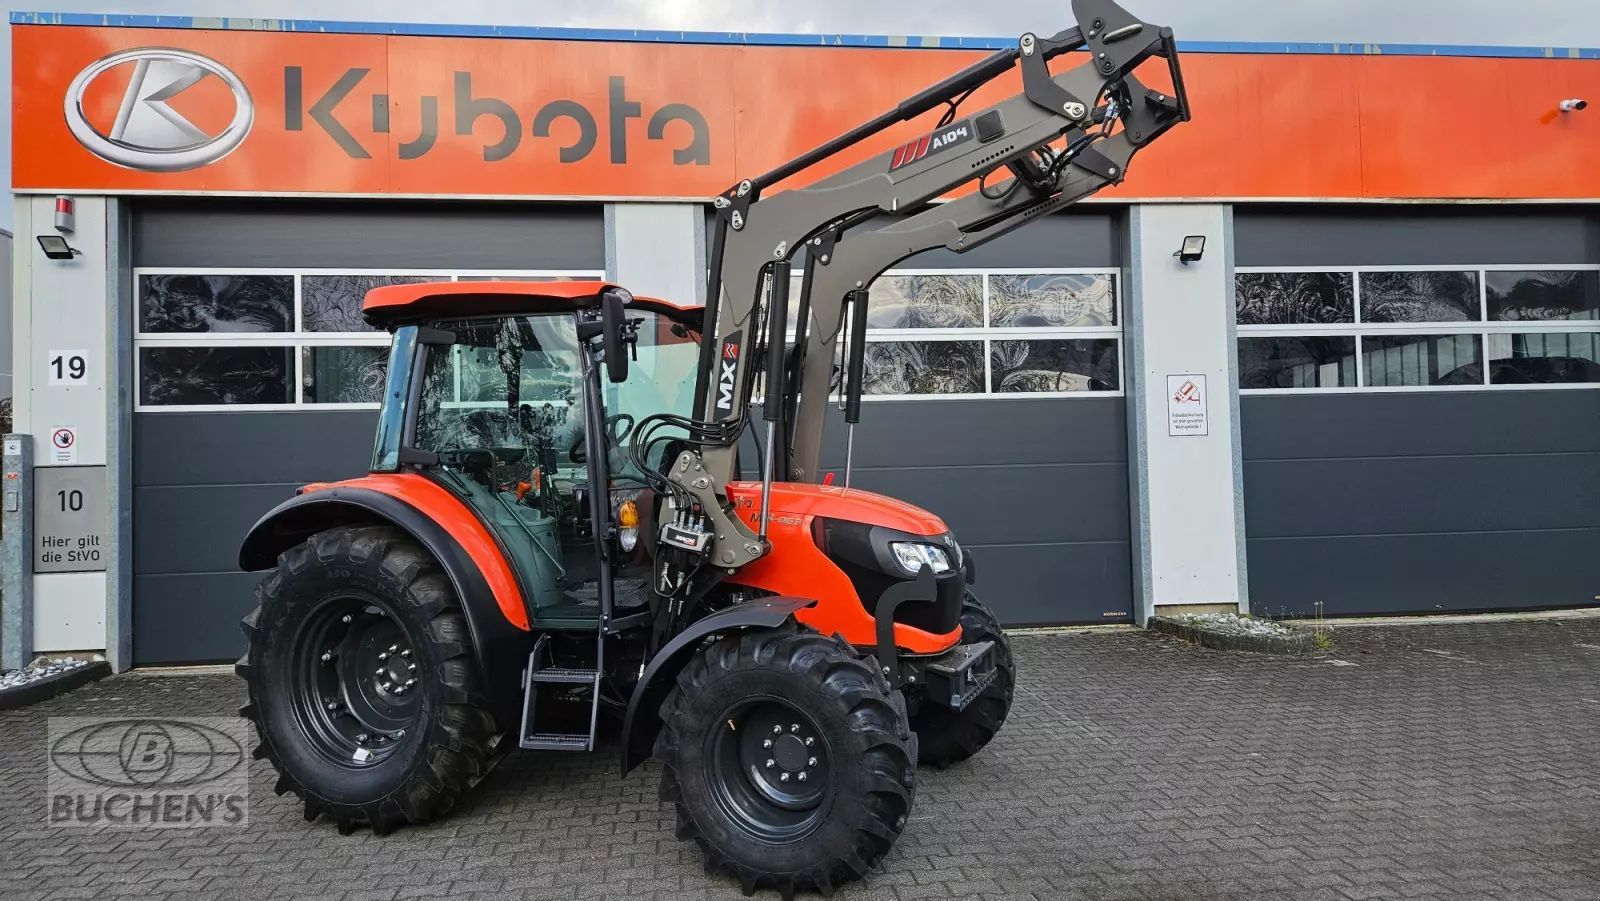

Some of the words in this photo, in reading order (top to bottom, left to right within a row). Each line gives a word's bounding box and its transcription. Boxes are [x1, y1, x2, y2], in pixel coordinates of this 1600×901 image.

[284, 66, 711, 166] Kubota
[932, 126, 968, 149] A104
[51, 355, 86, 379] 19
[717, 360, 737, 410] MX
[58, 489, 83, 512] 10
[42, 536, 71, 547] Hier
[78, 535, 100, 549] gilt
[41, 551, 62, 562] die
[67, 549, 100, 562] StVO
